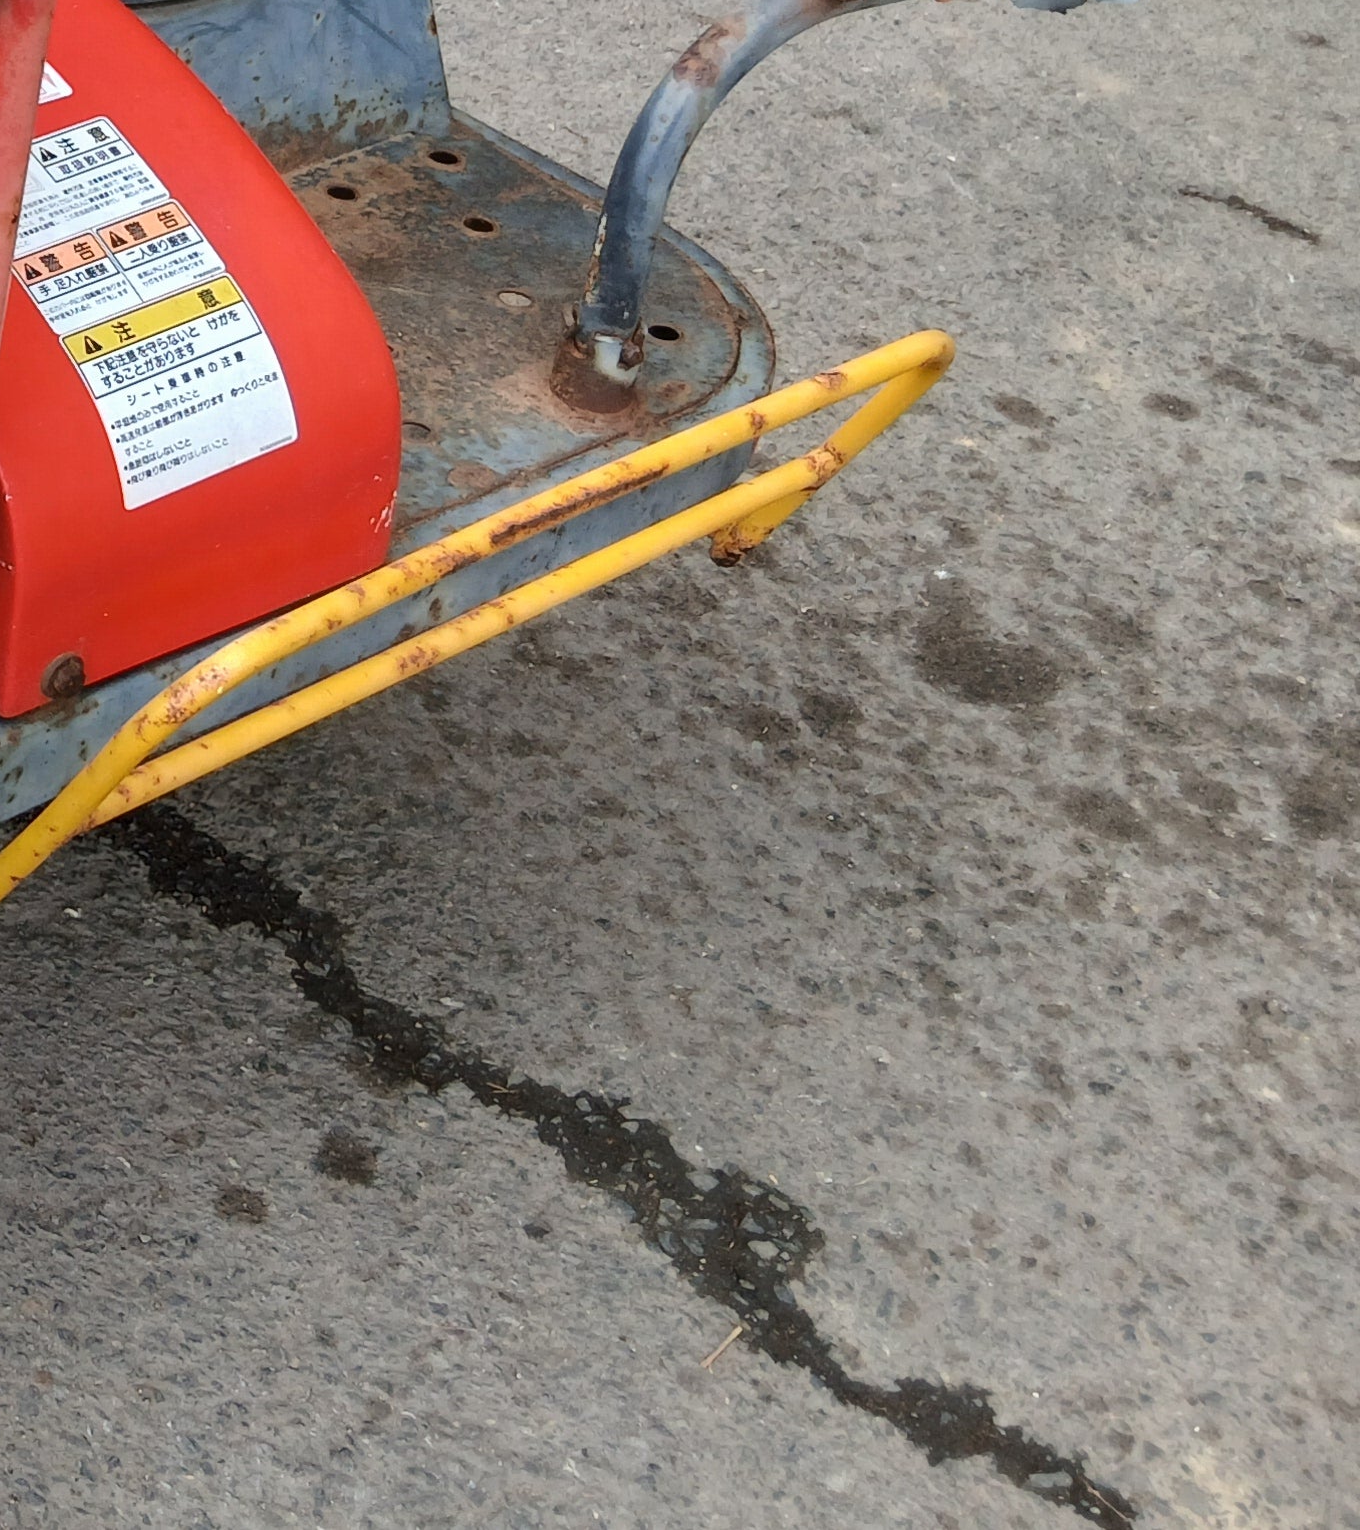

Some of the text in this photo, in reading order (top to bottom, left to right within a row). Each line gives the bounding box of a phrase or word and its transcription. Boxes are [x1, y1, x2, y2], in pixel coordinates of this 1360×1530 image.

[126, 232, 192, 264] 二人乗り厳禁
[92, 309, 241, 375] 下記注意を守らないと けがを
[100, 342, 196, 389] することがあります
